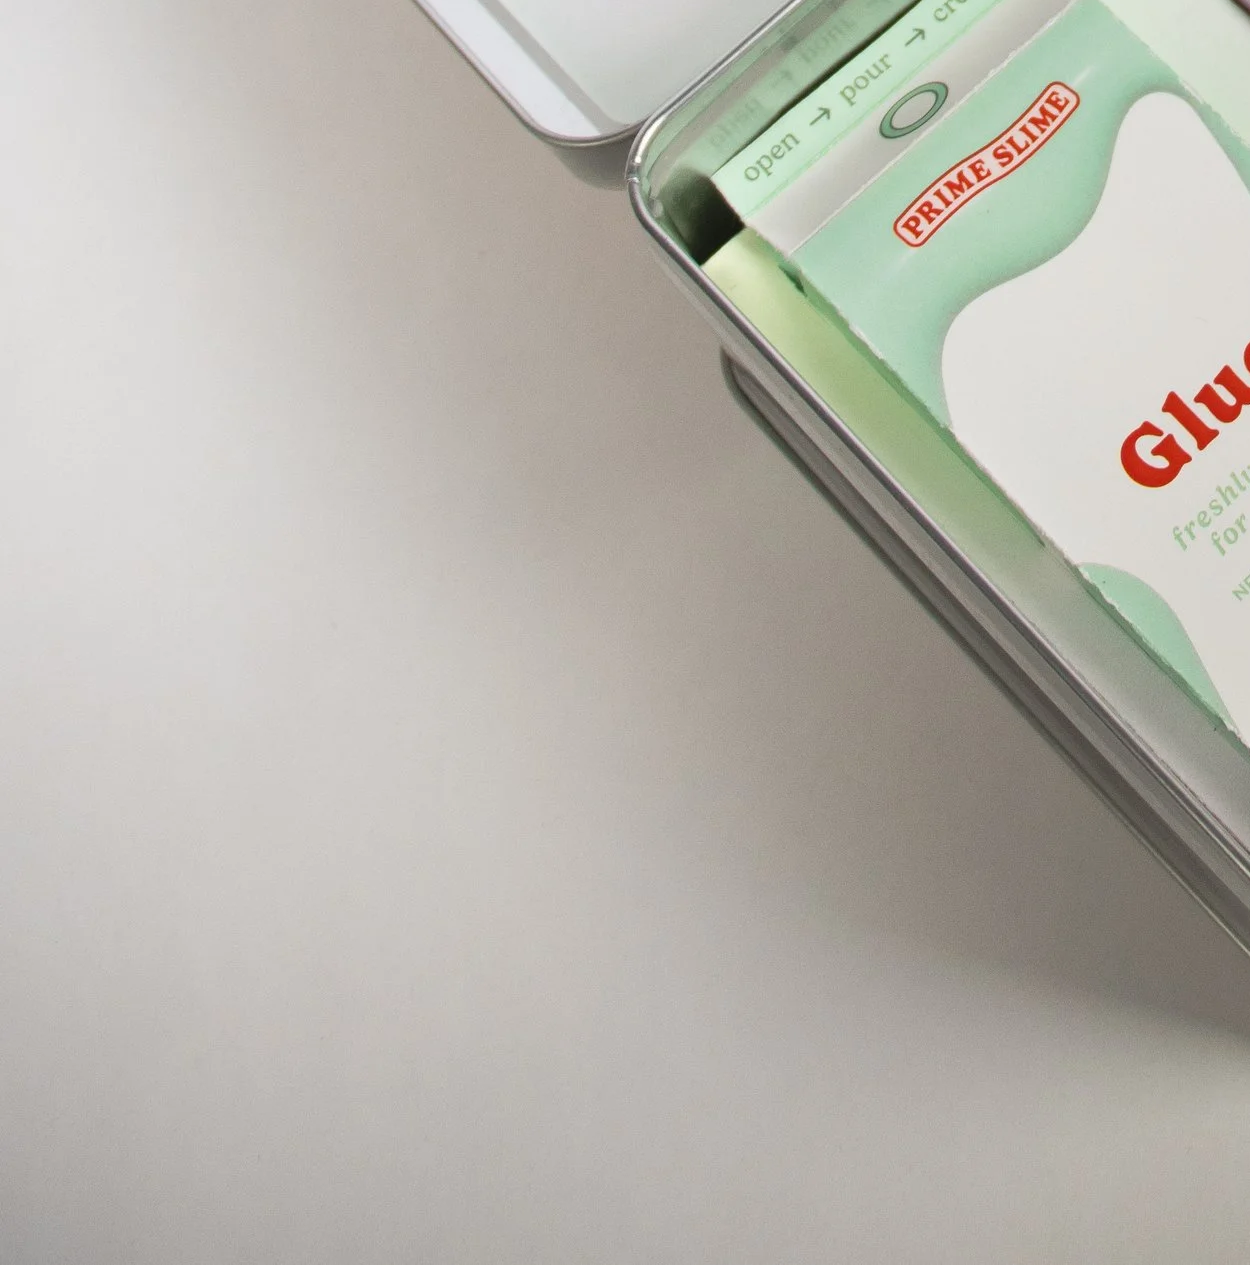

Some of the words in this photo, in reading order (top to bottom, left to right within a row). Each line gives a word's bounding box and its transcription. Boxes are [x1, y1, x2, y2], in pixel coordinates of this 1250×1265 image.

[744, 128, 801, 184] open
[838, 50, 893, 108] pour
[900, 156, 993, 240] PRIME
[992, 89, 1071, 168] SLIME
[1210, 512, 1249, 557] for
